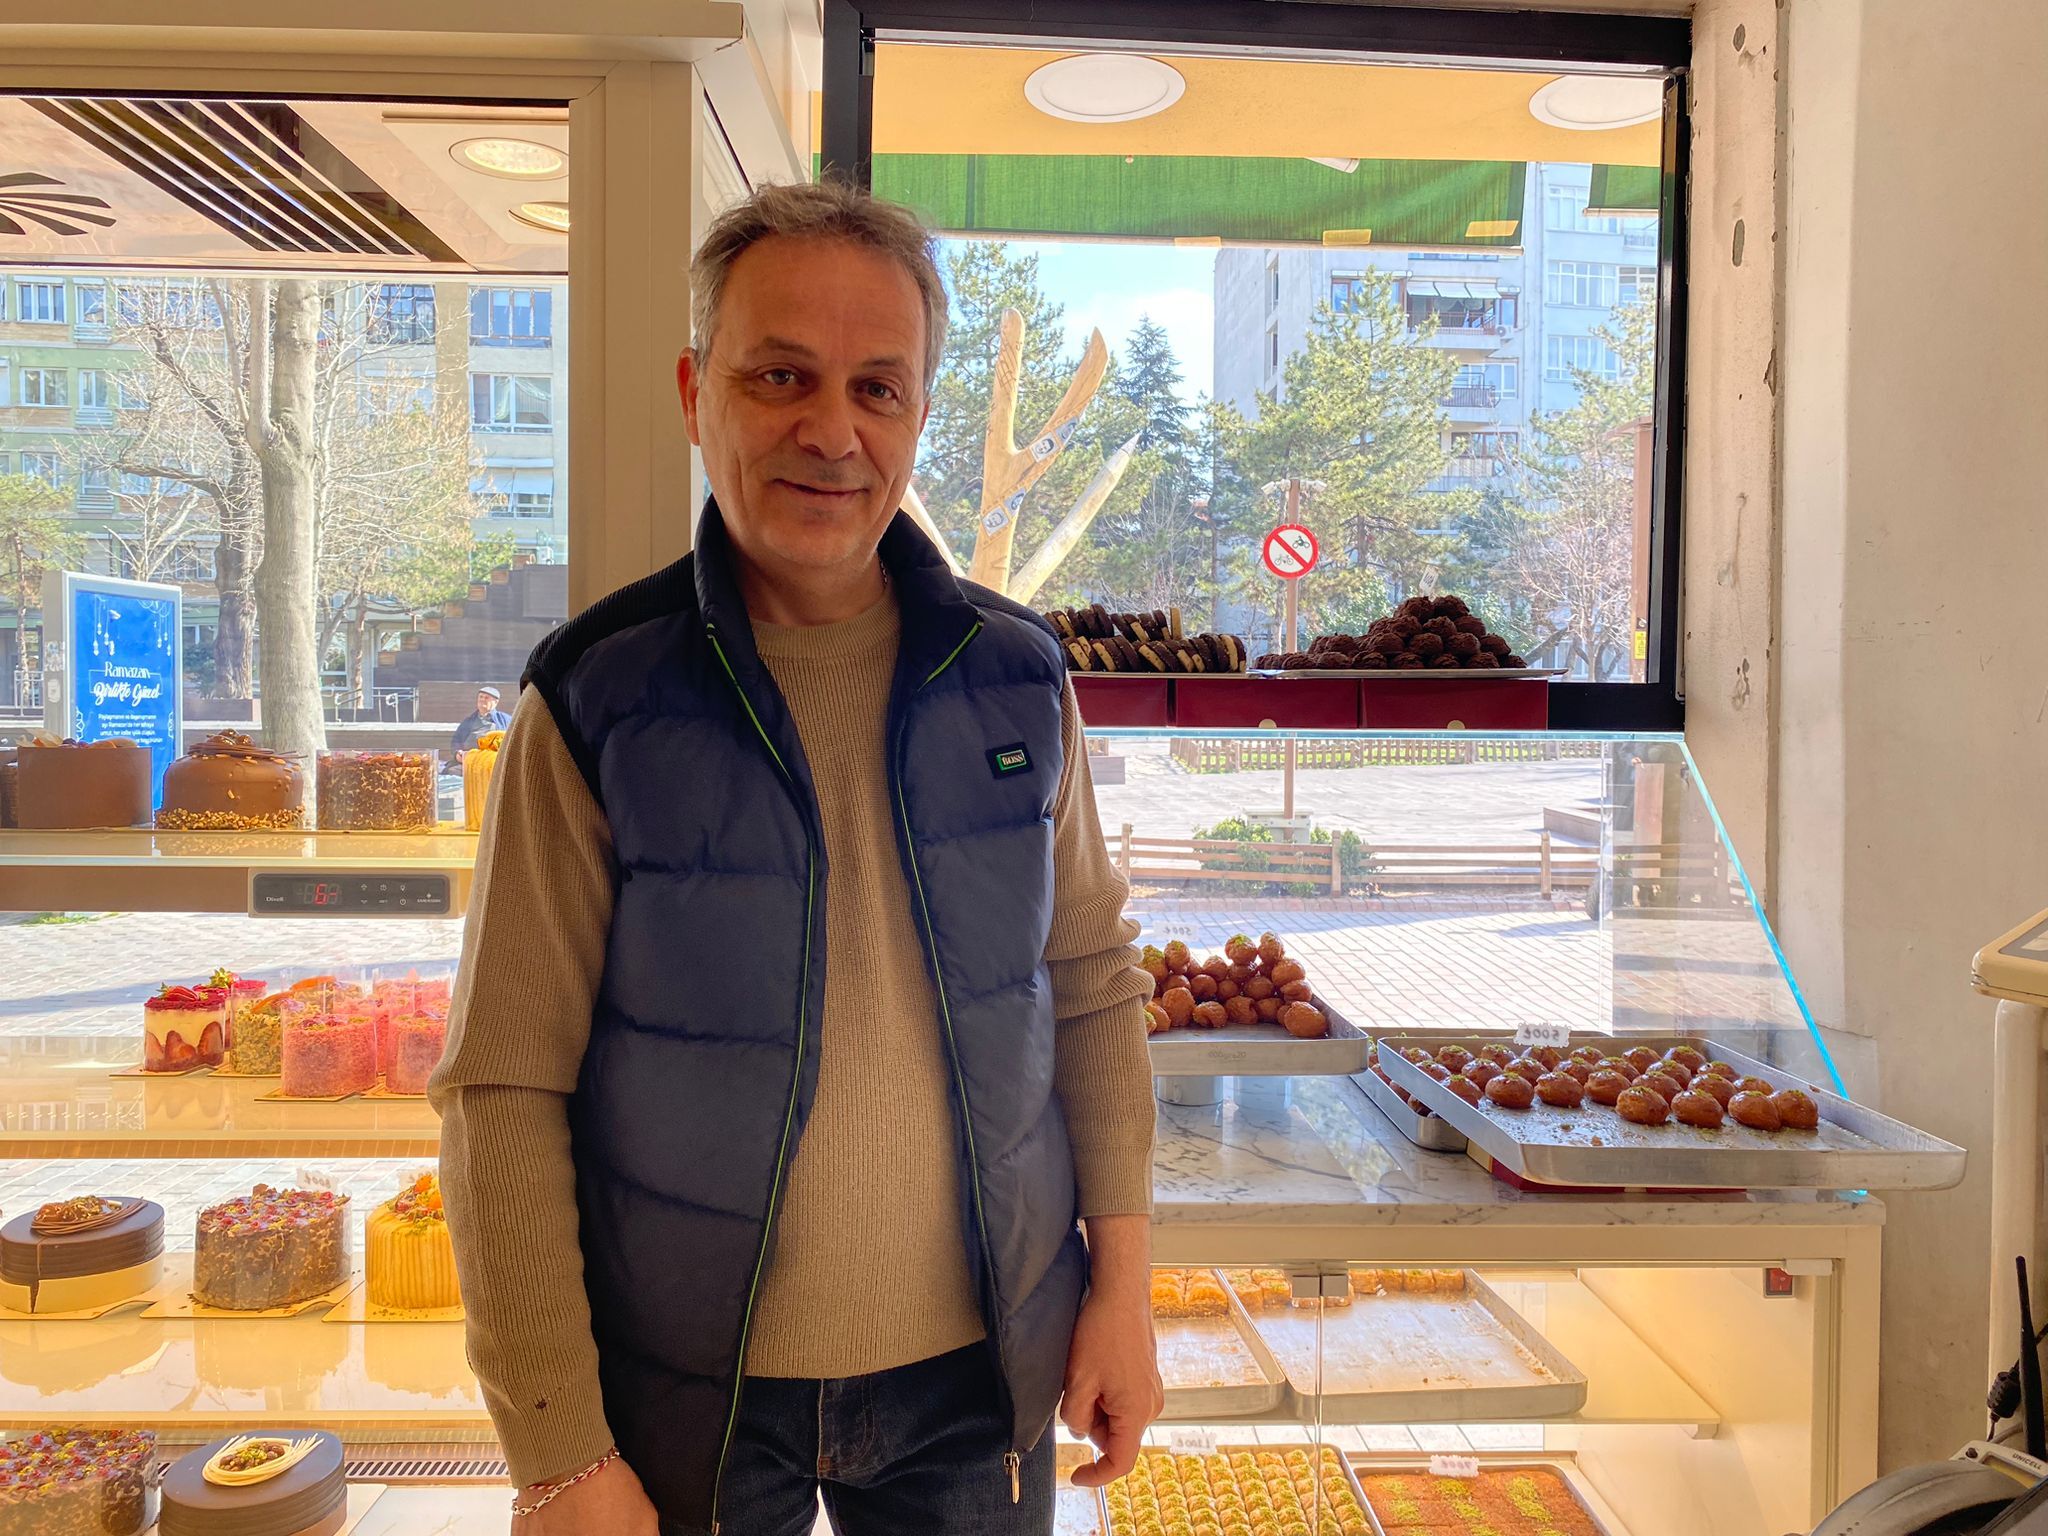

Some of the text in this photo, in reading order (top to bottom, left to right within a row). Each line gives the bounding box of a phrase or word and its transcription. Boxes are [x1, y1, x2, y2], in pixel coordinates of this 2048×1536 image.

[104, 661, 150, 679] Ramazan
[94, 681, 160, 707] Birlikte Güzel
[1001, 754, 1024, 766] BOSS
[2012, 1452, 2042, 1470] UNICELL
